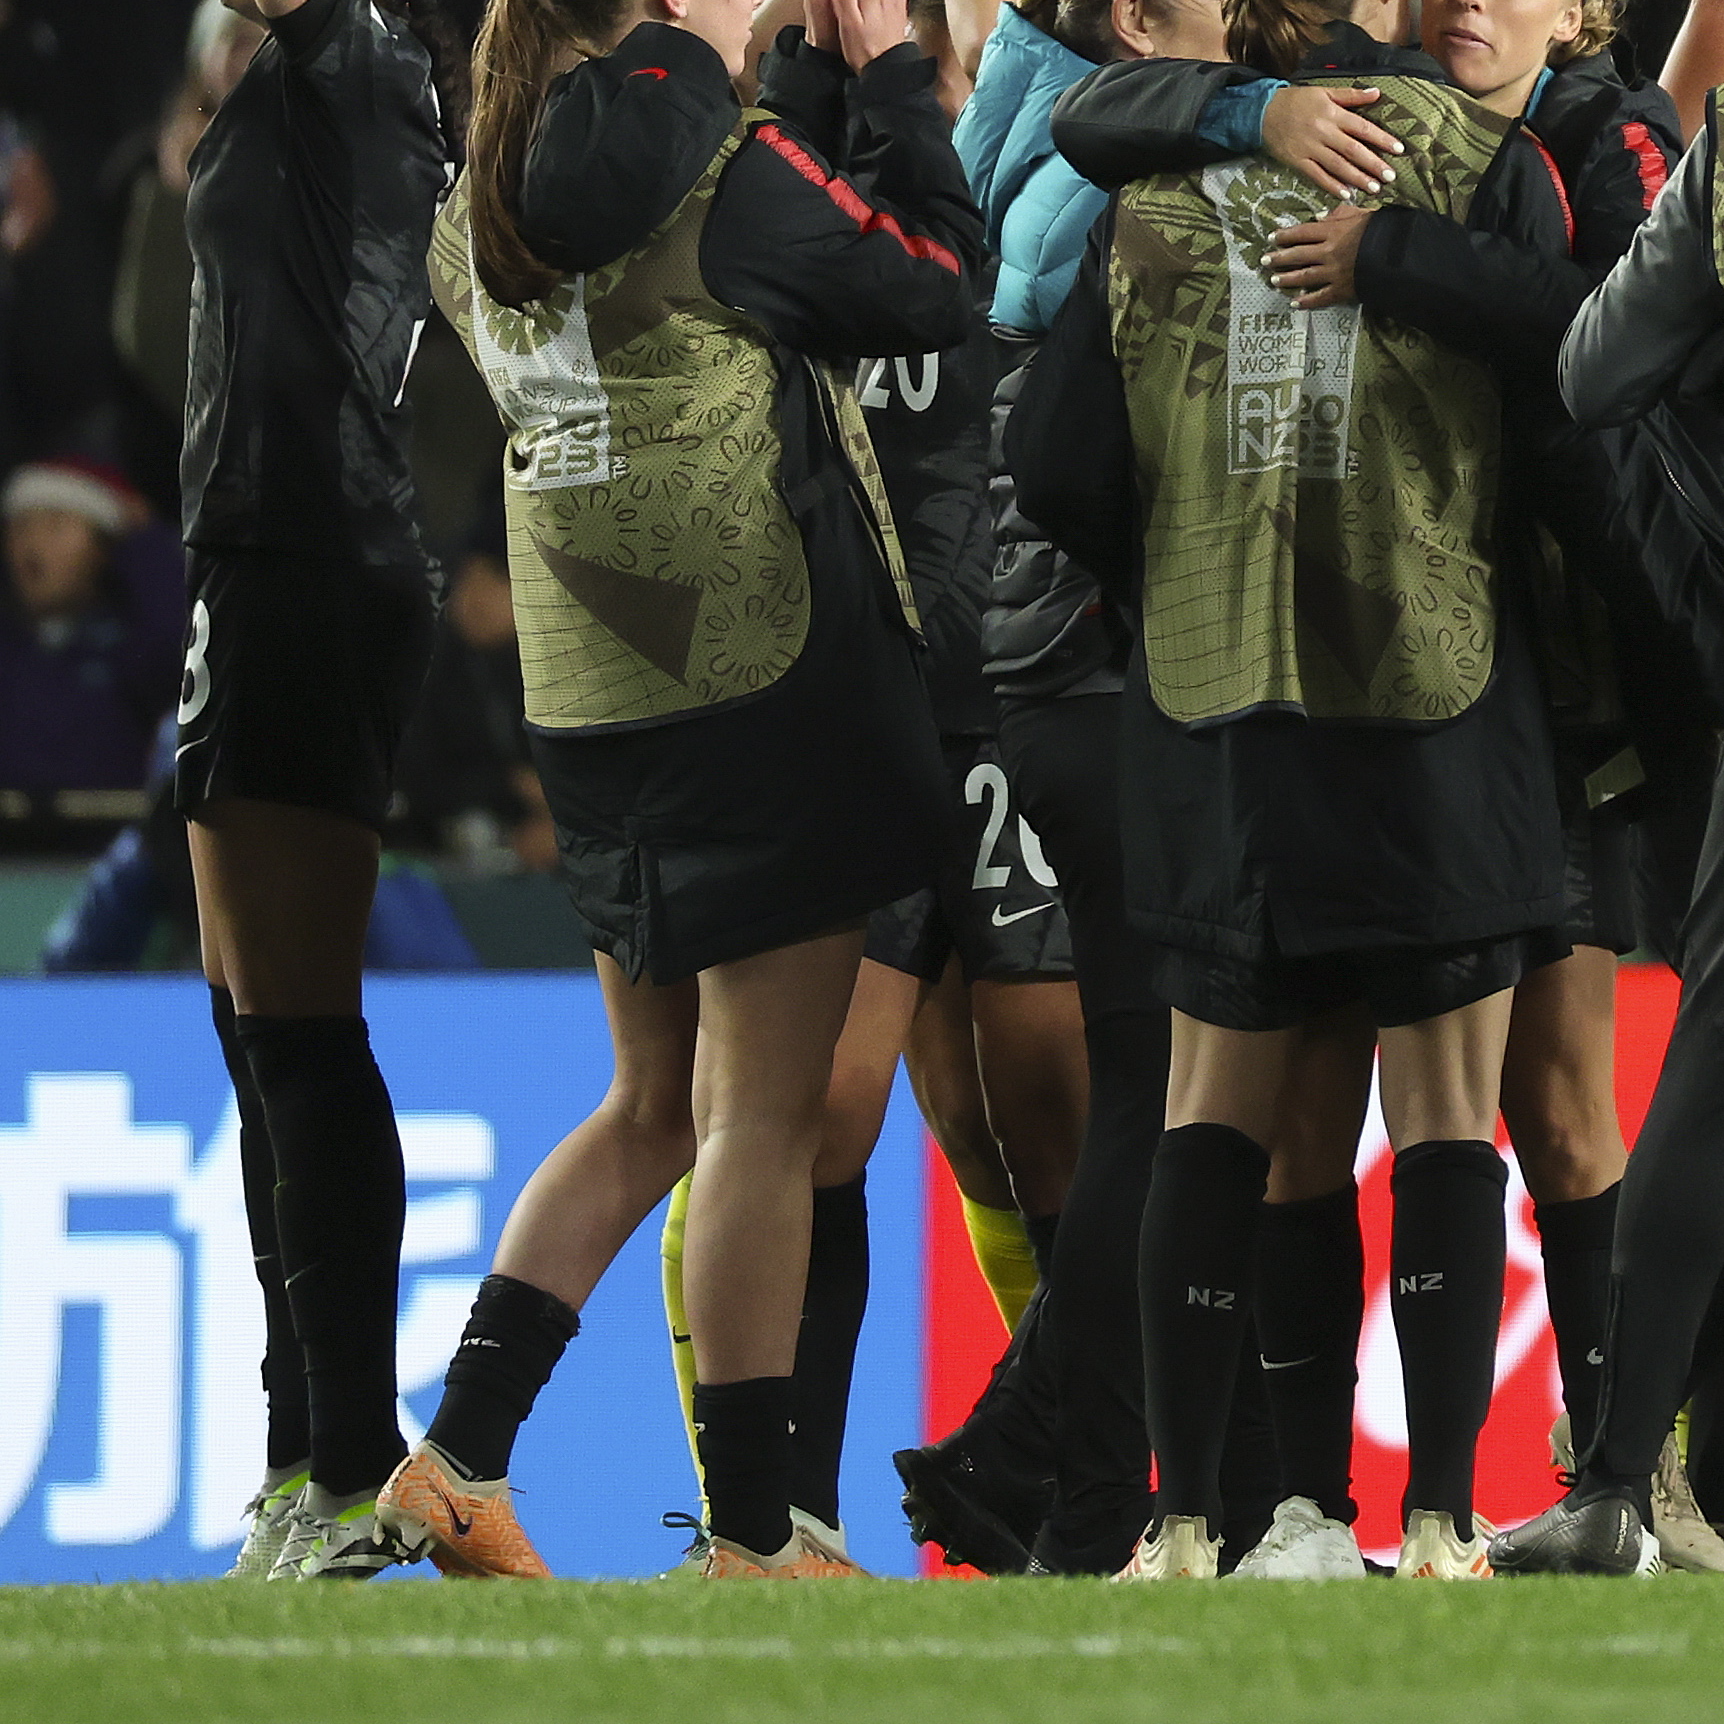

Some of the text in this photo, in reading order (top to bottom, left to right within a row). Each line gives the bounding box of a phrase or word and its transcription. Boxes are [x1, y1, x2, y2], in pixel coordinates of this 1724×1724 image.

[1239, 312, 1293, 333] FIFA
[1399, 1272, 1444, 1296] NZ
[1187, 1285, 1236, 1311] NZ
